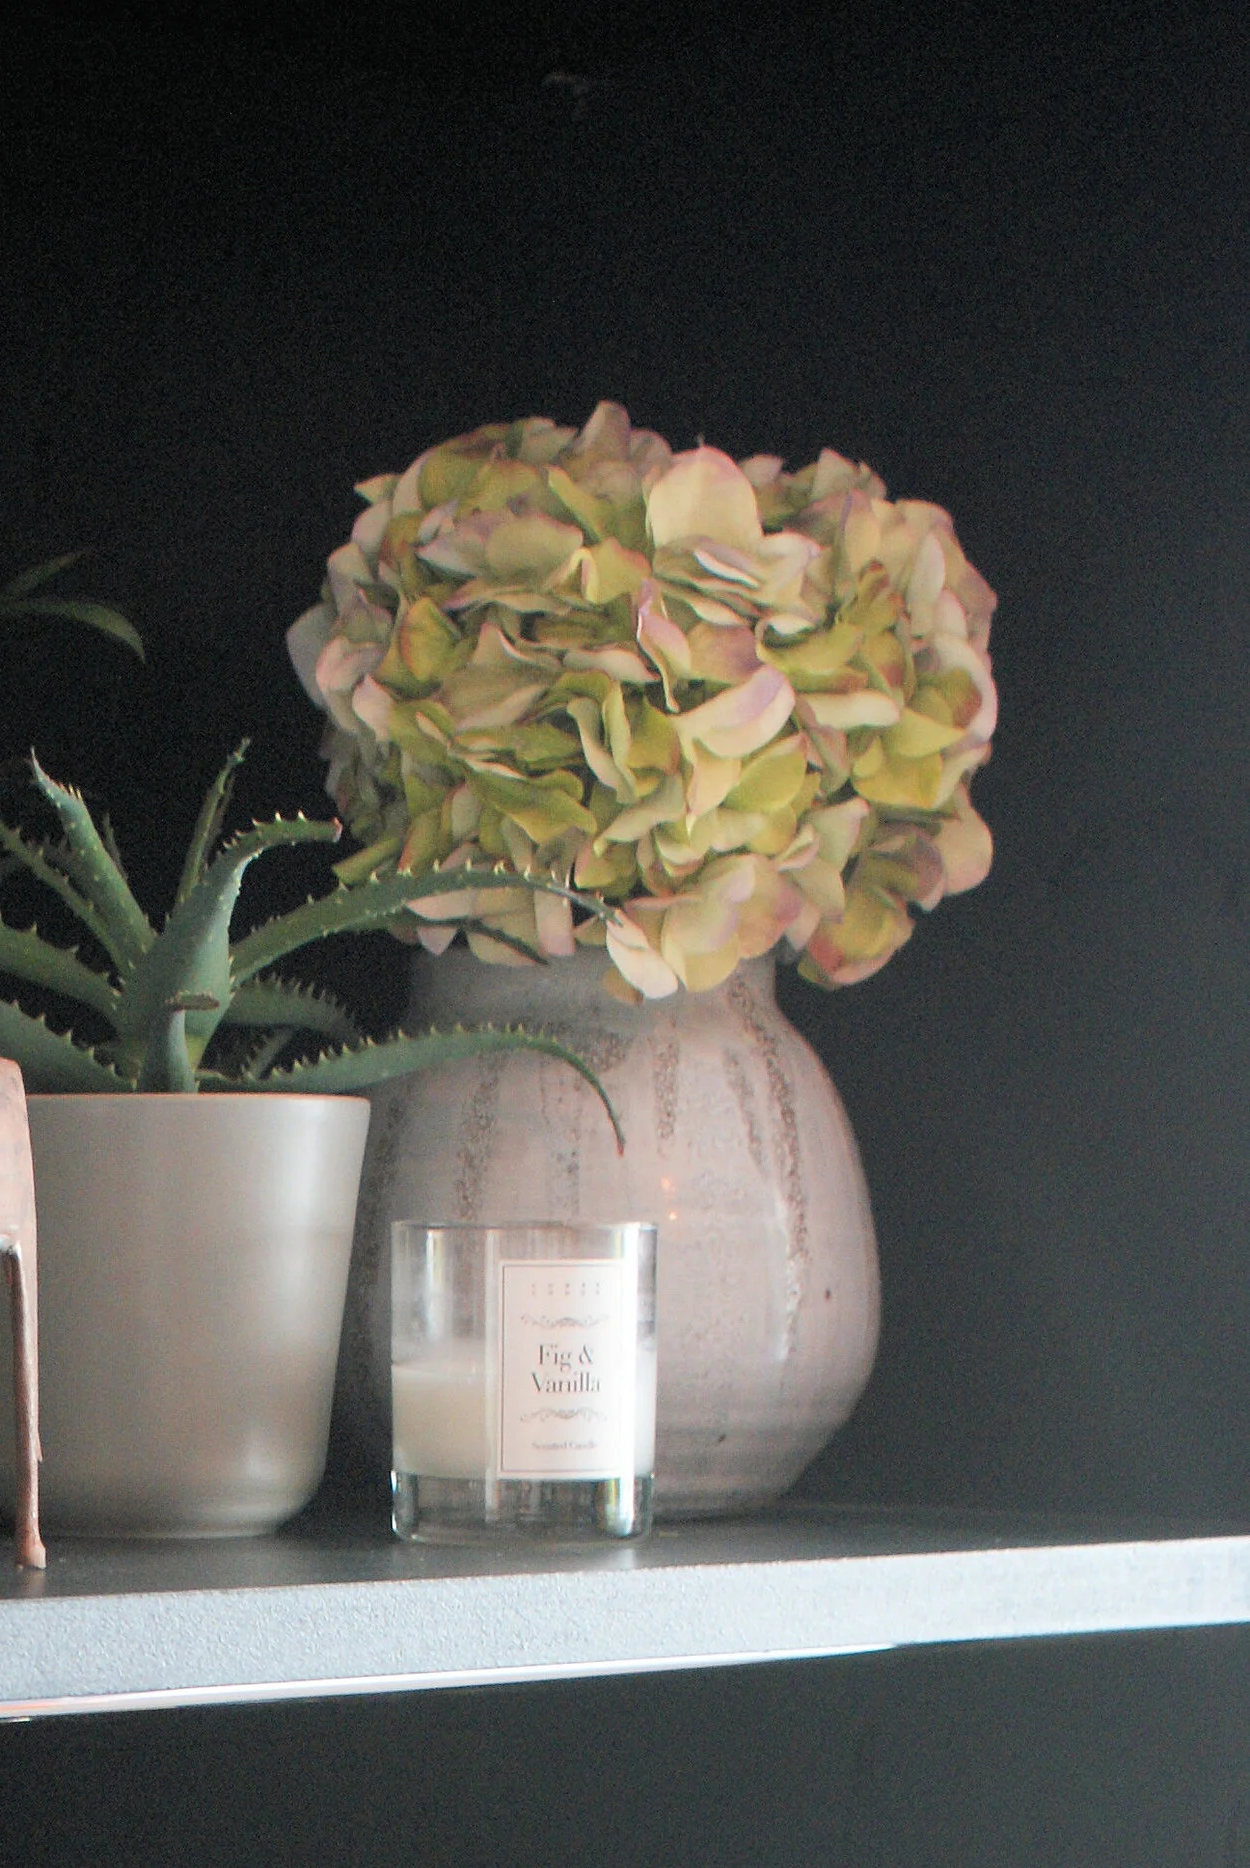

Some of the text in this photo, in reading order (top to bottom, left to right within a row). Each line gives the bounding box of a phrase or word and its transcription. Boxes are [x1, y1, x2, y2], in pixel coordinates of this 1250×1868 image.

[538, 1344, 594, 1373] Fig &
[530, 1371, 601, 1393] Vanilla
